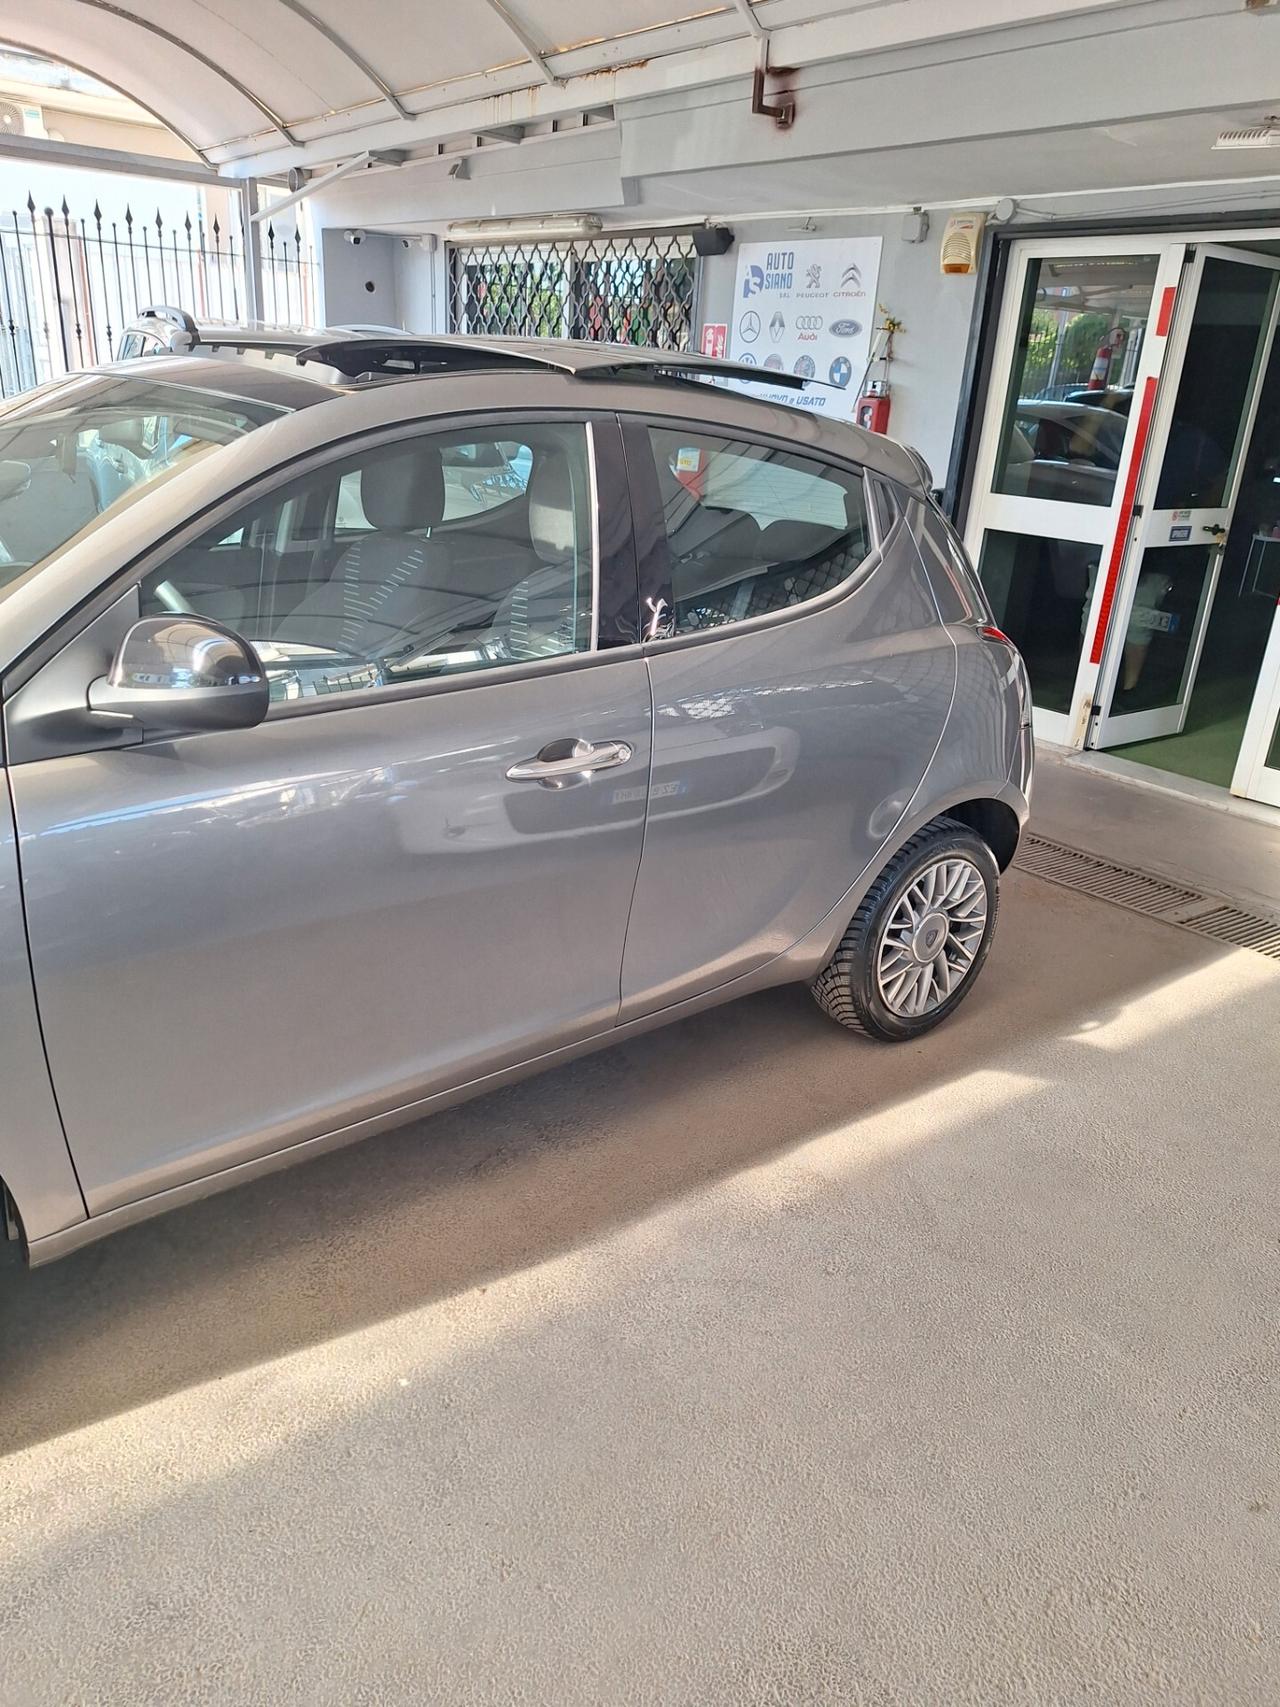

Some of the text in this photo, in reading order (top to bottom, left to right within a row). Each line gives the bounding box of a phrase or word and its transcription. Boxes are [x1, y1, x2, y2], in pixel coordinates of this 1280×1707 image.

[767, 252, 794, 270] AUTO
[765, 273, 793, 290] SIANO
[797, 332, 818, 341] Audi
[796, 395, 827, 407] USATO
